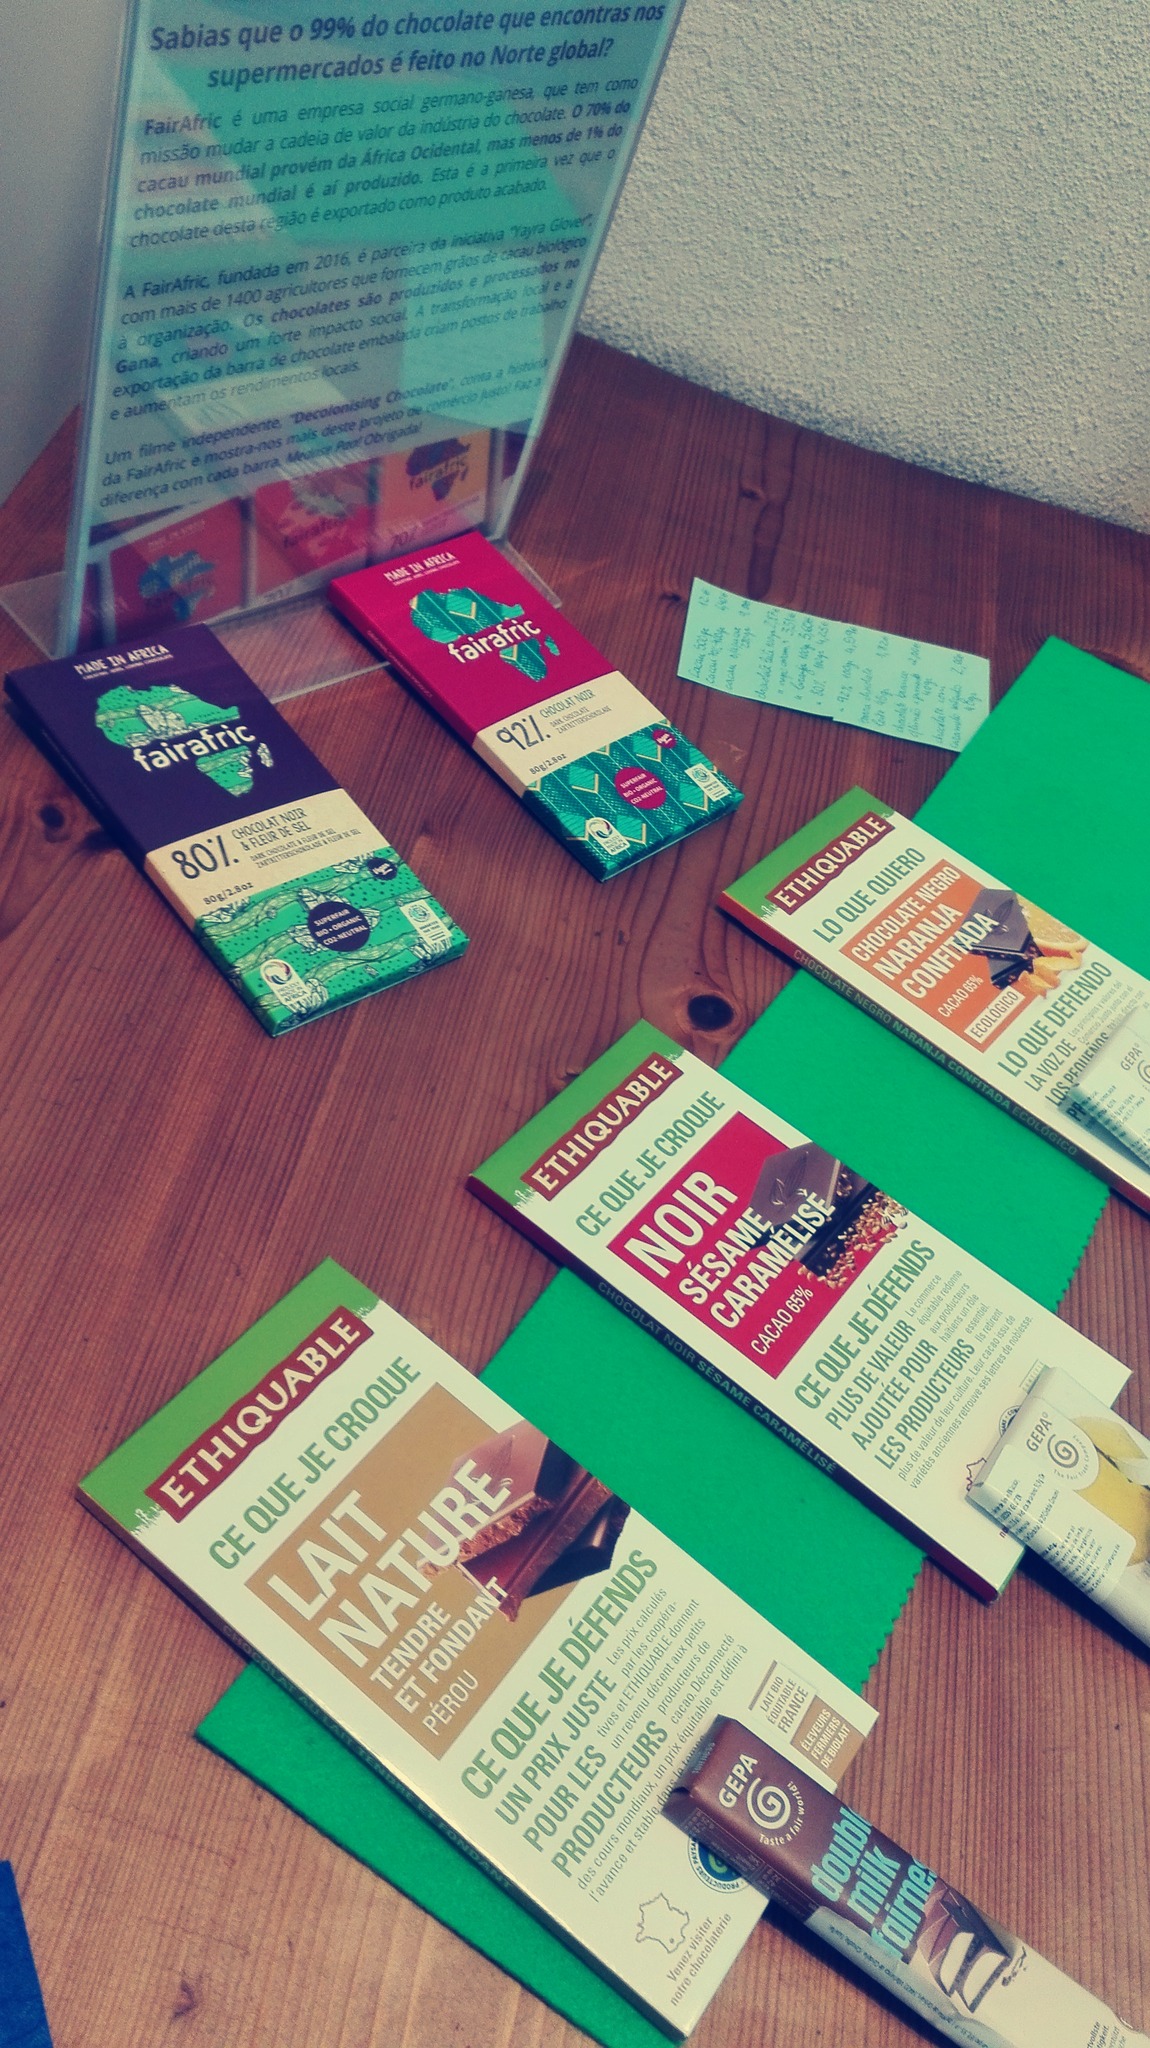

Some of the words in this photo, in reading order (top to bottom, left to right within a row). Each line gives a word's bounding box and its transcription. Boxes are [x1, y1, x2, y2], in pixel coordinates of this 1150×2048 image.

[149, 22, 233, 51] Sabias
[238, 25, 282, 51] que
[288, 24, 303, 42] o
[309, 16, 354, 42] 99%
[361, 14, 389, 38] do
[393, 9, 494, 36] chocolate
[499, 11, 536, 35] que
[539, 4, 631, 27] encontras
[633, 4, 665, 22] nos
[207, 53, 385, 90] supermercados
[389, 48, 402, 73] é
[407, 47, 454, 72] feito
[460, 50, 485, 68] no
[490, 43, 545, 65] Norte
[546, 36, 614, 66] global?
[144, 111, 222, 136] FairAfric
[231, 108, 242, 128] é
[253, 110, 287, 126] uma
[297, 103, 364, 123] empresa
[371, 94, 414, 114] social
[419, 88, 535, 114] germano-ganesa,
[542, 85, 568, 102] que
[573, 81, 598, 96] tem
[604, 78, 638, 93] como
[382, 565, 412, 582] MADE
[407, 560, 425, 574] IN
[421, 550, 457, 569] AFRICA
[73, 657, 110, 676] MADE
[106, 653, 127, 667] IN
[125, 642, 170, 663] AFRICA
[445, 615, 541, 664] fairafric
[538, 695, 577, 719] CHOCOLAT
[572, 687, 597, 703] NOIR
[132, 719, 255, 774] fairafric
[495, 714, 550, 756] 92%
[528, 752, 568, 775] 80g/2.8oz
[619, 771, 648, 789] SUPERFAIR
[621, 789, 633, 799] BIO
[635, 775, 658, 791] ORGANIC
[629, 783, 664, 805] CO2-NEUTRAL
[230, 814, 281, 840] CHOCOLAT
[277, 806, 309, 824] NOIR
[239, 840, 252, 853] &
[248, 829, 282, 850] FLEUR
[276, 824, 295, 839] DE
[290, 818, 312, 834] SEL
[170, 834, 237, 880] 80%
[772, 815, 888, 908] ETHIQUABLE
[201, 880, 255, 905] 80g/2.8oz
[312, 907, 351, 927] SUPERFAIR
[812, 918, 843, 943] LO
[836, 889, 877, 922] QUE
[867, 847, 925, 895] QUIERO
[851, 895, 927, 961] CHOCOLATE
[914, 865, 960, 904] NEGRO
[314, 927, 328, 938] BIO
[332, 913, 363, 931] ORGANIC
[322, 922, 369, 946] CO2-NEUTRAL
[872, 902, 964, 980] NARANJA
[901, 911, 1000, 998] CONFITADA
[937, 988, 969, 1017] CACAO
[961, 973, 984, 993] 65%
[968, 990, 1019, 1039] ECOLÓGICO
[997, 1050, 1028, 1077] LO
[1017, 1019, 1058, 1055] QUE
[1043, 961, 1111, 1028] DEFIENDO
[792, 949, 855, 997] CHOCOLATE
[853, 991, 892, 1023] NEGRO
[891, 1019, 947, 1064] NARANJA
[947, 1059, 1011, 1110] CONFITADA
[1011, 1104, 1077, 1155] ECOLÓGICO
[1024, 1072, 1048, 1092] LA
[1036, 1051, 1065, 1077] VOZ
[1054, 1037, 1078, 1058] DE
[1120, 1044, 1143, 1071] GEPA
[1043, 1080, 1071, 1106] LOS
[530, 1058, 674, 1190] ETHIQUABLE
[575, 1203, 611, 1235] CE
[599, 1168, 646, 1211] QUE
[631, 1148, 666, 1183] JE
[654, 1089, 726, 1156] CROQUE
[625, 1172, 738, 1275] NOIR
[678, 1205, 773, 1304] SÉSAME
[711, 1187, 836, 1326] CARAMÉLISÉ
[751, 1309, 793, 1354] CACAO
[785, 1283, 814, 1313] 65%
[794, 1372, 832, 1409] CE
[815, 1333, 862, 1383] QUE
[843, 1310, 879, 1351] JE
[861, 1238, 935, 1322] DÉFENDS
[596, 1282, 663, 1335] CHOCOLAT
[662, 1333, 695, 1364] NOIR
[695, 1360, 752, 1407] SÉSAME
[752, 1405, 837, 1474] CARAMÉLISÉ
[824, 1387, 864, 1431] PLUS
[852, 1366, 880, 1393] DE
[866, 1318, 917, 1372] VALEUR
[850, 1376, 911, 1452] AJOUTÉE
[897, 1338, 940, 1383] POUR
[908, 1455, 936, 1489] variétés
[931, 1417, 962, 1458] anciennes
[957, 1387, 982, 1420] retrouve
[977, 1374, 991, 1390] ses
[984, 1352, 1006, 1377] lettres
[1000, 1343, 1013, 1355] de
[1007, 1315, 1033, 1346] noblesse.
[160, 1315, 360, 1507] ETHIQUABLE
[874, 1435, 907, 1471] LES
[894, 1337, 975, 1442] PRODUCTEURS
[210, 1524, 255, 1567] CE
[244, 1472, 306, 1532] QUE
[292, 1442, 335, 1489] JE
[324, 1355, 420, 1450] CROQUE
[1025, 1416, 1053, 1451] GEPA
[268, 1489, 386, 1618] LAIT
[320, 1459, 510, 1664] NATURE
[368, 1600, 452, 1689] TENDRE
[394, 1666, 432, 1712] ET
[421, 1575, 509, 1679] FONDANT
[667, 1597, 700, 1638] donnent
[462, 1748, 507, 1796] CE
[491, 1691, 550, 1758] QUE
[532, 1657, 576, 1710] JE
[558, 1550, 657, 1669] DÉFENDS
[621, 1634, 673, 1700] ETHIQUABLE
[758, 1689, 775, 1713] LAIT
[769, 1675, 784, 1694] BIO
[421, 1668, 479, 1736] PÉROU
[594, 1710, 619, 1737] tives
[615, 1697, 628, 1711] et
[765, 1677, 798, 1725] ÉQUITABLE
[776, 1685, 809, 1734] FRANCE
[494, 1784, 533, 1824] UN
[521, 1732, 571, 1790] PRIX
[558, 1669, 617, 1745] JUSTE
[799, 1708, 832, 1752] ÉLEVEURS
[809, 1715, 841, 1760] FERMIERS
[819, 1750, 835, 1769] DE
[827, 1722, 851, 1756] BIOLAIT
[521, 1784, 580, 1851] POUR
[566, 1744, 606, 1790] LES
[550, 1720, 667, 1877] PRODUCTEURS
[718, 1753, 758, 1807] GEPA
[786, 1780, 807, 1816] world!
[758, 1832, 786, 1847] Taste
[788, 1817, 805, 1837] fair
[845, 1845, 902, 1922] milk
[664, 1947, 692, 1981] Venez
[686, 1914, 712, 1949] visiter
[669, 1976, 692, 2007] notre
[688, 1912, 731, 1977] chocolaterie
